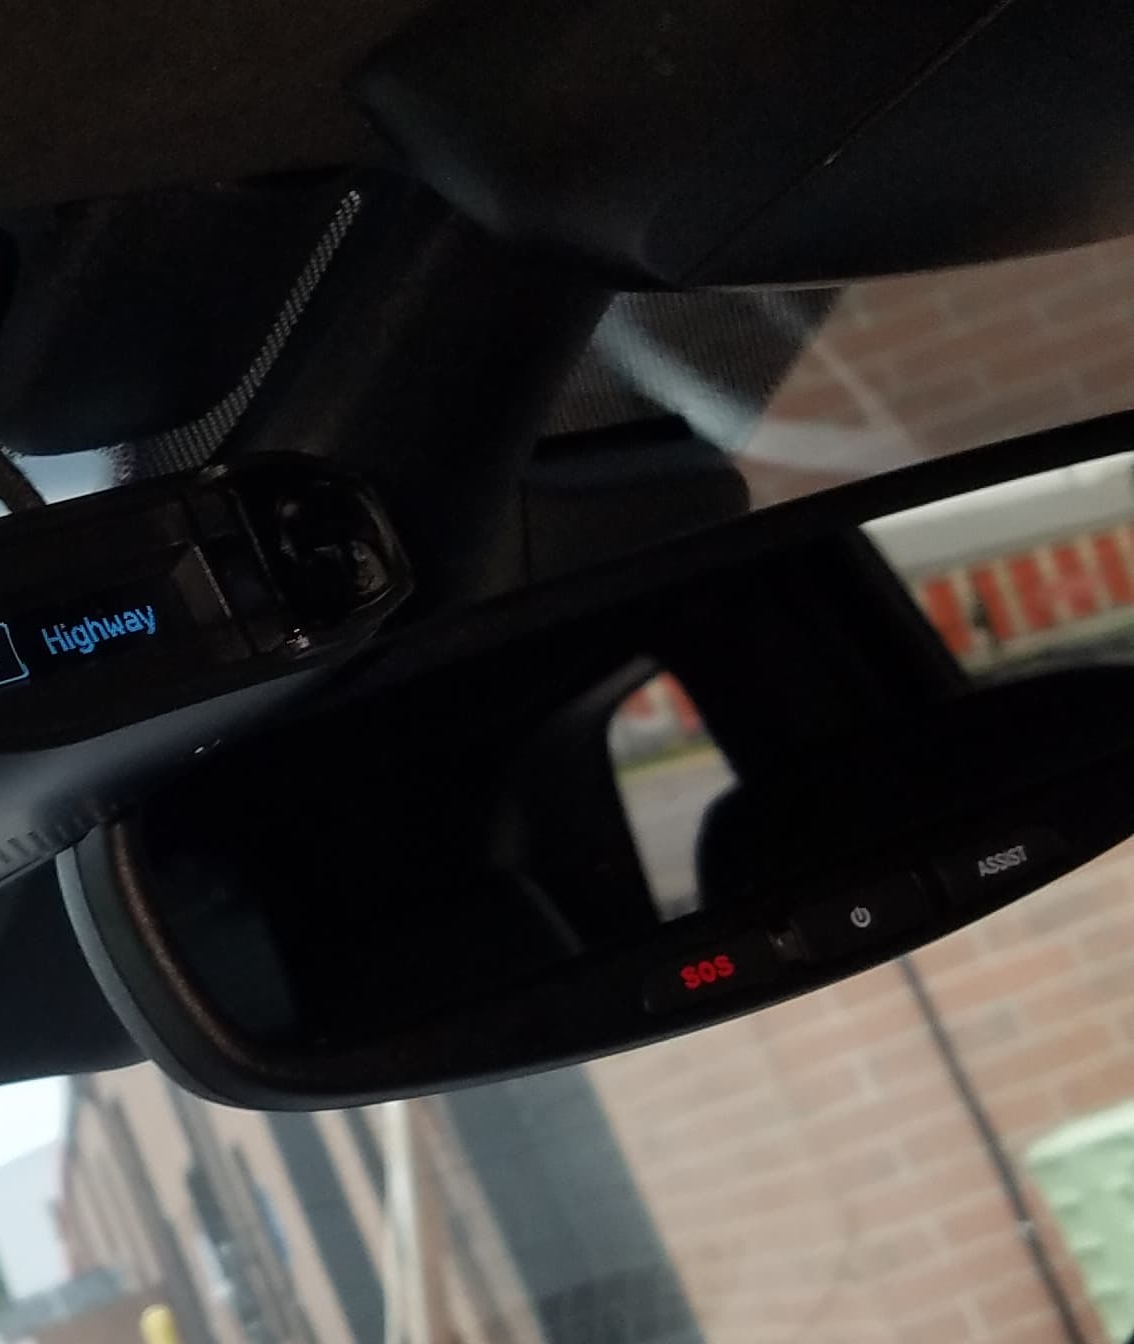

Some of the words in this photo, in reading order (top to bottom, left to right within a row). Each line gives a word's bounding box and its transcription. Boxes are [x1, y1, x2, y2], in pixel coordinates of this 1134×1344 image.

[42, 605, 156, 654] Highway
[977, 845, 1027, 877] ASSIST
[681, 955, 734, 989] SOS
